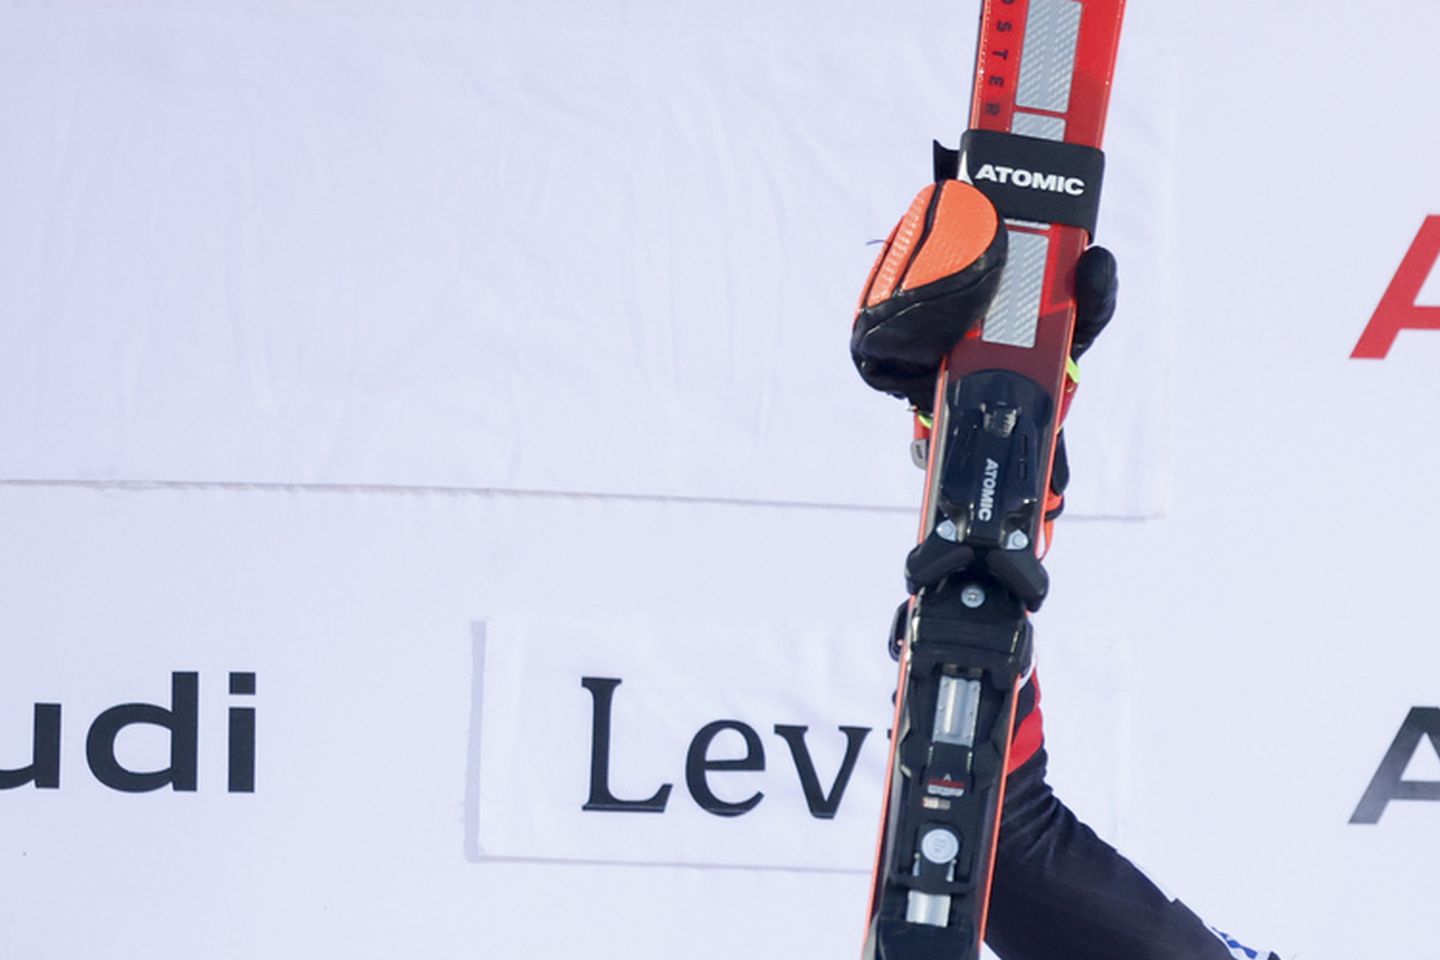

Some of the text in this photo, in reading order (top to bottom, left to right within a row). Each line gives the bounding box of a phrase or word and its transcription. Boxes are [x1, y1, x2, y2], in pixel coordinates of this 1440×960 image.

[975, 163, 1086, 196] ATOMIC
[978, 458, 999, 521] ATOMIC
[582, 677, 893, 819] Lev
